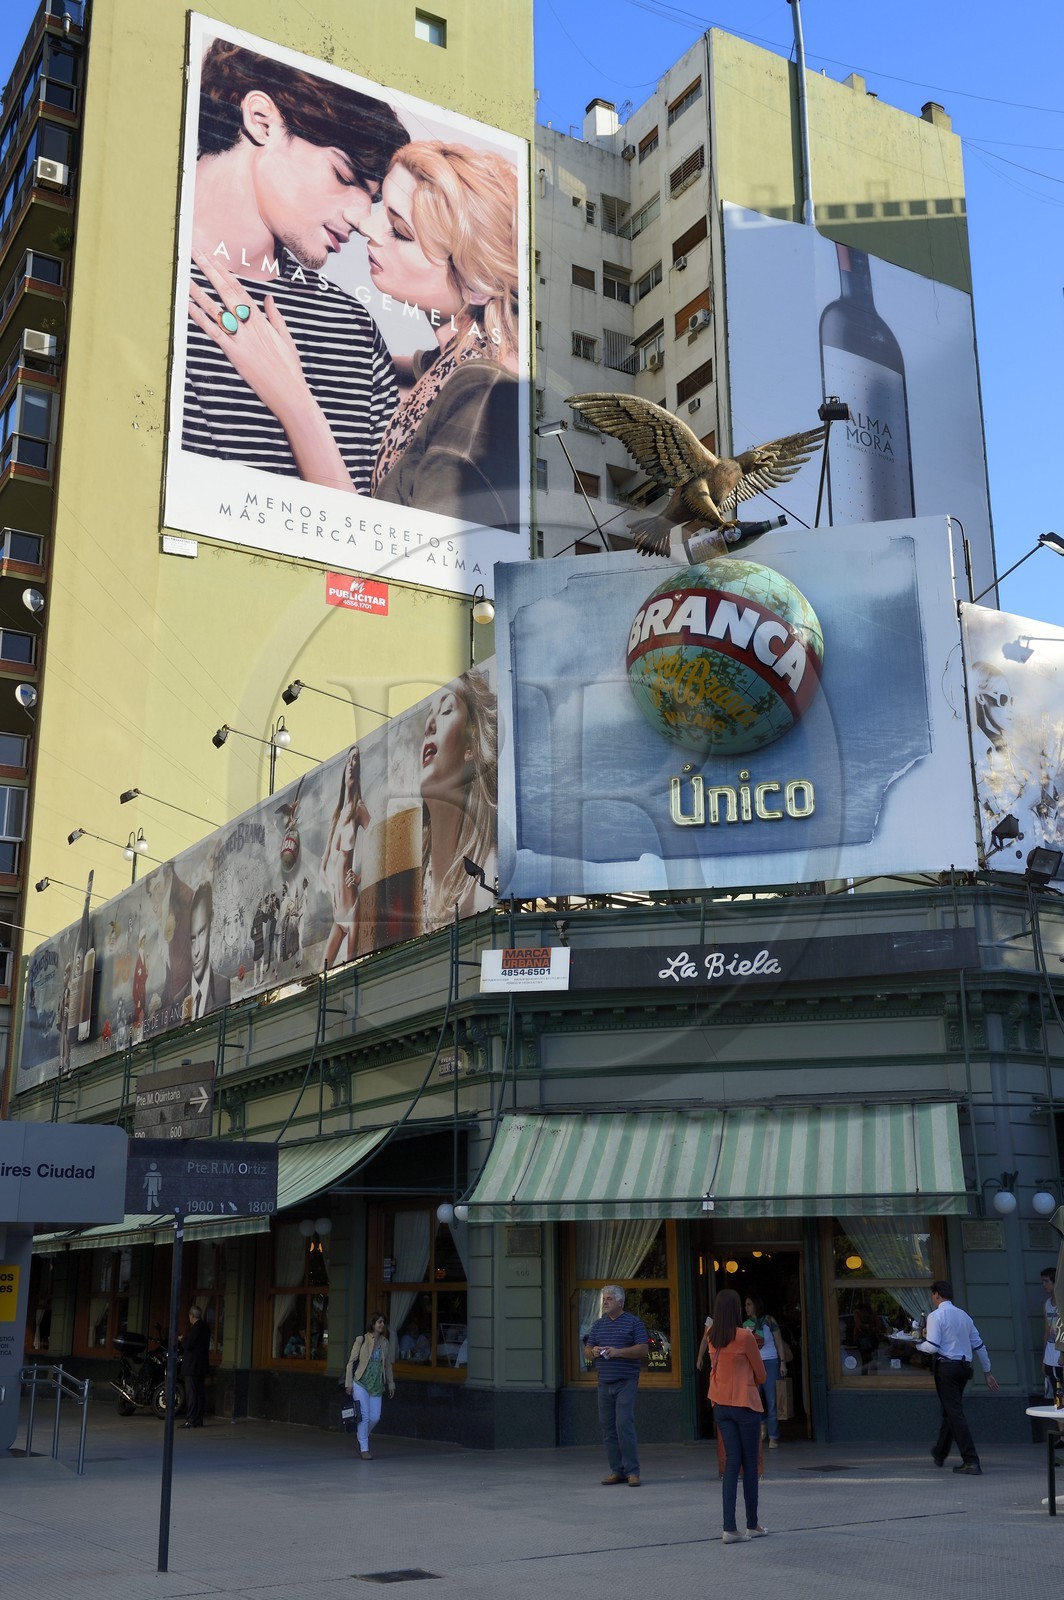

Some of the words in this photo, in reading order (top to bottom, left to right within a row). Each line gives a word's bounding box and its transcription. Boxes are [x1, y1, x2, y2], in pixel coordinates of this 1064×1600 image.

[213, 240, 330, 291] ALMAS
[354, 285, 502, 345] GEMELAS
[845, 425, 895, 457] MORA
[245, 492, 328, 522] MENOS
[344, 516, 460, 556] SECRETOS,
[218, 503, 266, 525] MÁS
[284, 518, 357, 546] CERCA
[374, 539, 410, 558] DEL
[426, 552, 488, 576] ALMA.
[328, 587, 386, 607] PUBLICITAR
[627, 595, 808, 694] BRANCA
[664, 711, 727, 733] MILANO
[669, 762, 816, 828] Único
[502, 959, 550, 968] URBANA
[504, 949, 549, 958] MARCA
[501, 968, 551, 976] 4854-6501
[658, 951, 698, 982] La
[704, 949, 782, 980] Biela
[169, 1126, 183, 1138] 600
[37, 1163, 96, 1179] Ciudad
[186, 1200, 214, 1213] 1900
[247, 1201, 275, 1213] 1800
